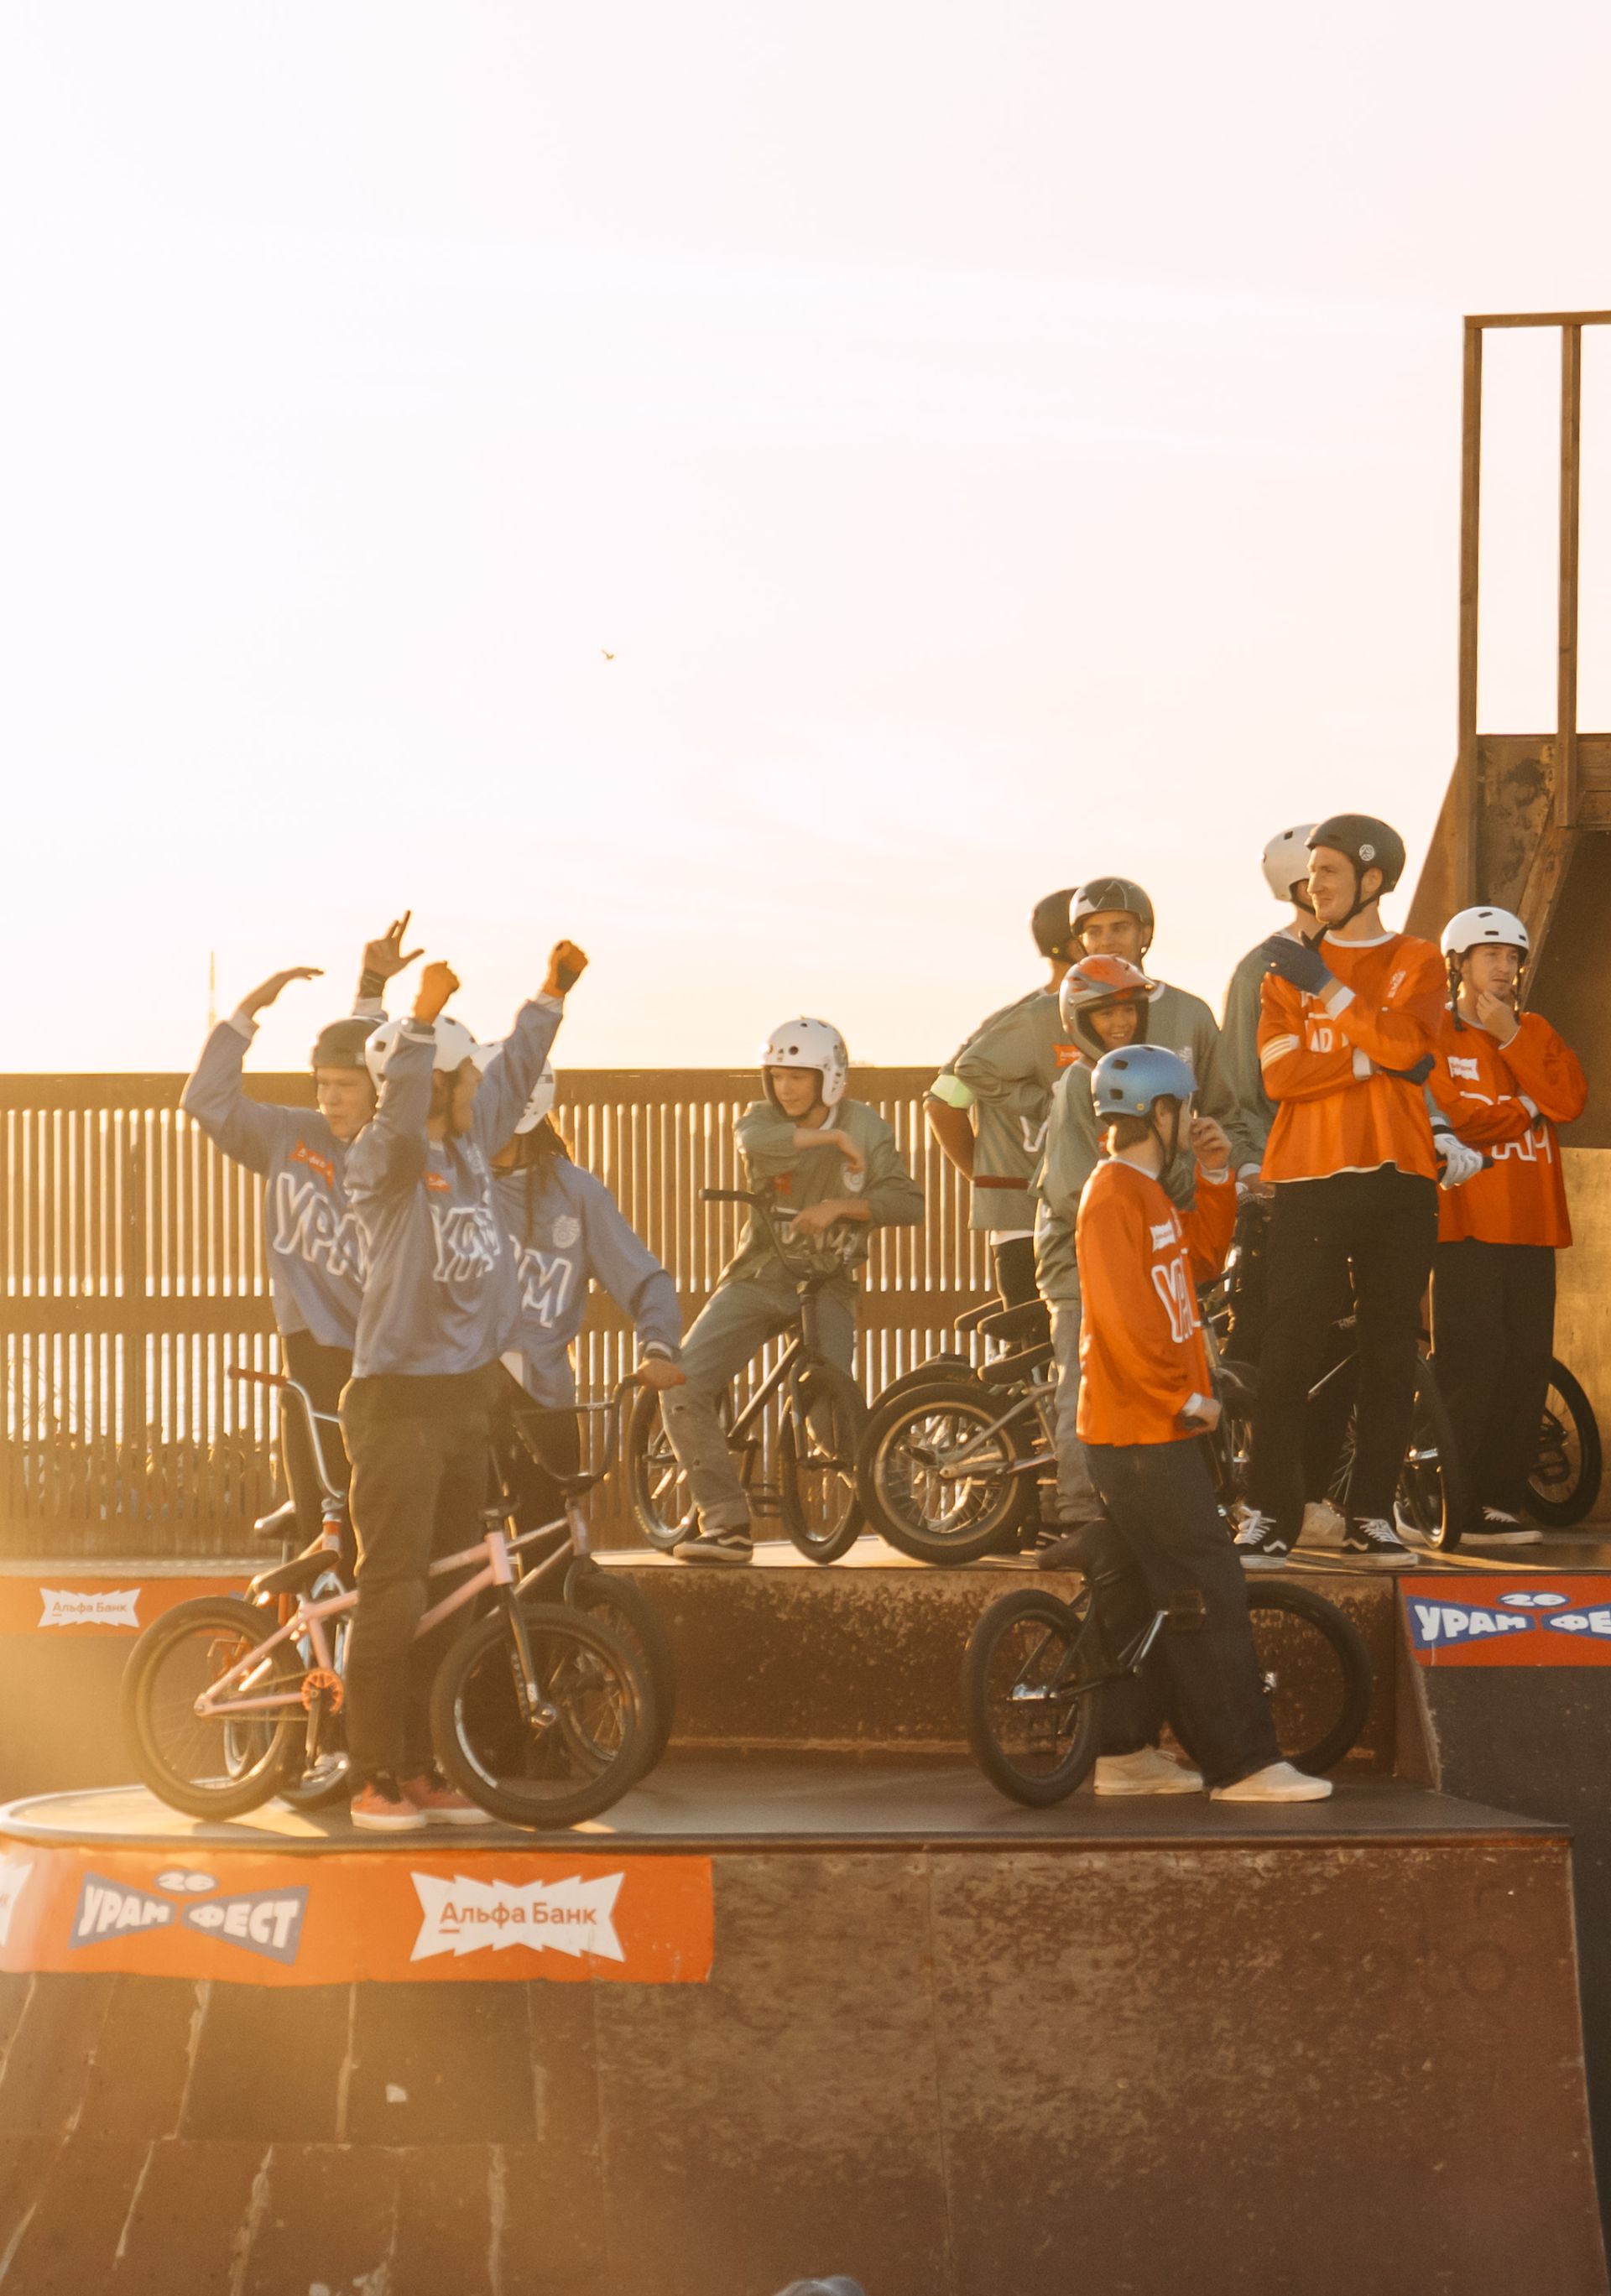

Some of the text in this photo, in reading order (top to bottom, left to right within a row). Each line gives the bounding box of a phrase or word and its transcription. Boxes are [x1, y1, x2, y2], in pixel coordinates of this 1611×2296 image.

[273, 1172, 372, 1284] УРА
[52, 1601, 127, 1616] Альфа Банк
[1414, 1604, 1527, 1641] УРАМ
[78, 1884, 300, 1948] УРАМ ФЕСТ
[439, 1901, 597, 1934] Альфа Банк
